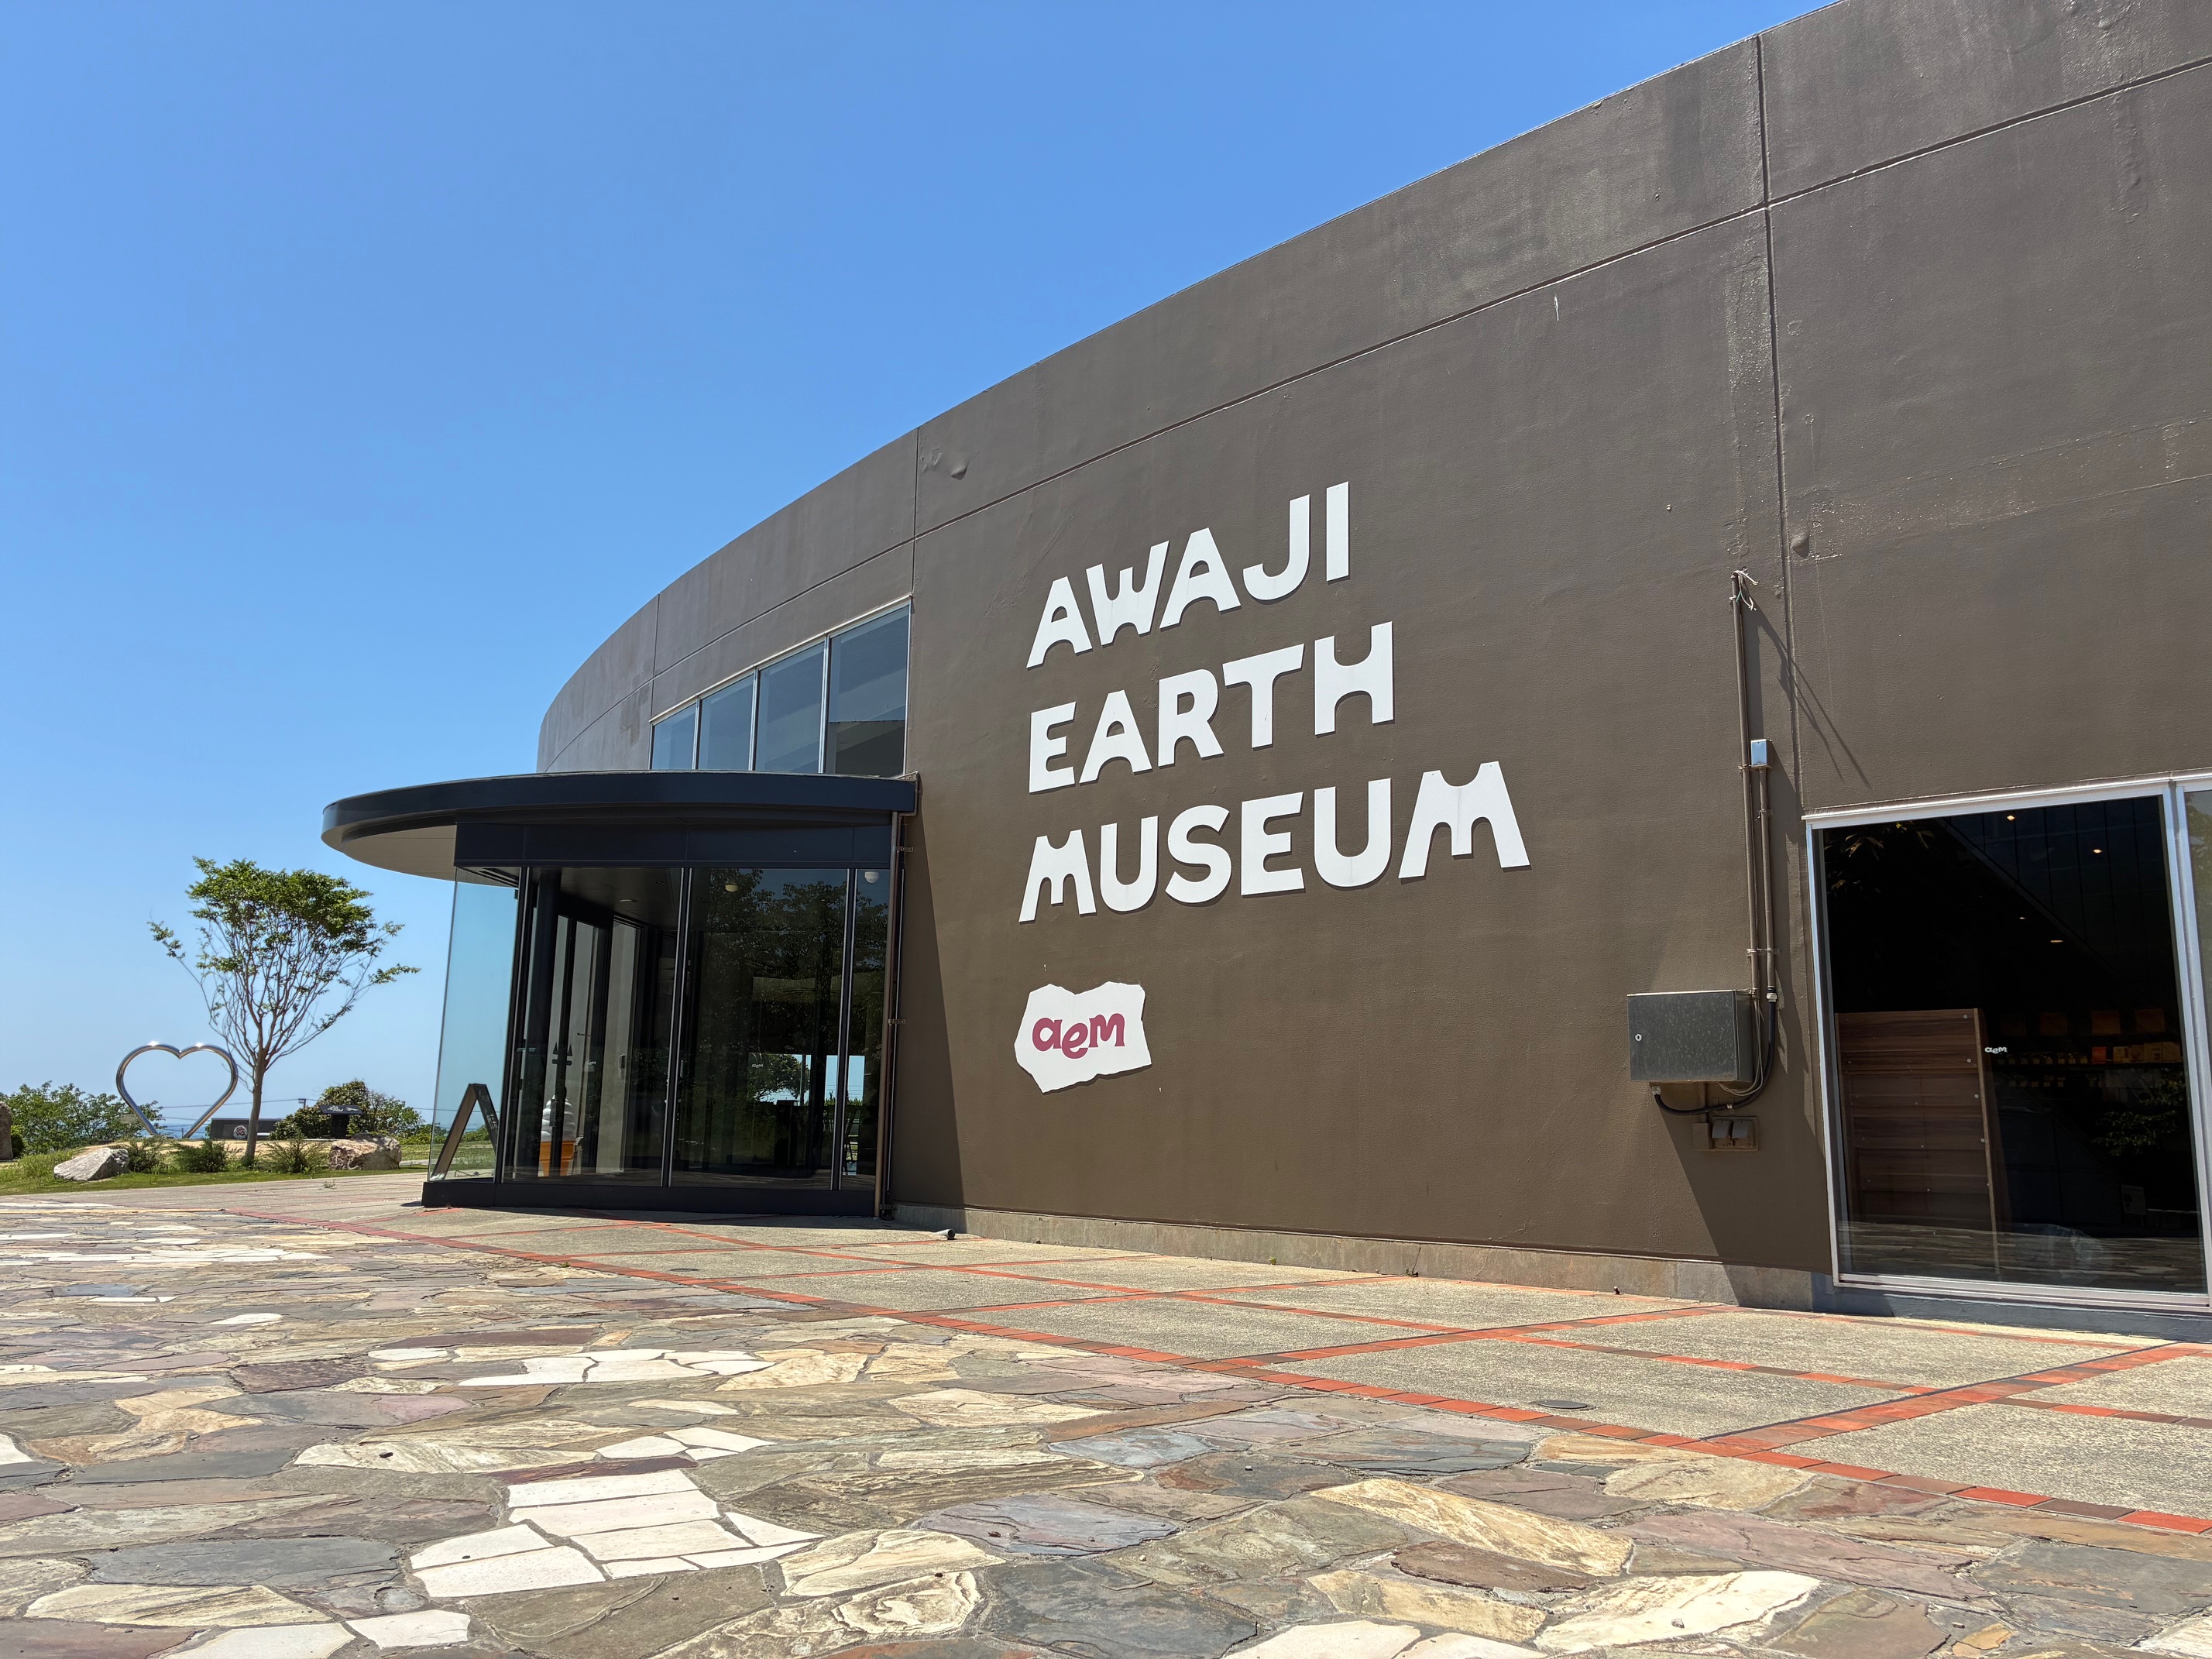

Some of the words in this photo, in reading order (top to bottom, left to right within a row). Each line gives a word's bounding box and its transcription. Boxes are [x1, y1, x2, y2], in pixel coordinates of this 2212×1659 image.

[1026, 481, 1349, 668] AWAJI
[1029, 620, 1394, 793] EARTH
[1018, 761, 1530, 922] MUSEUM
[1032, 1013, 1125, 1059] aem
